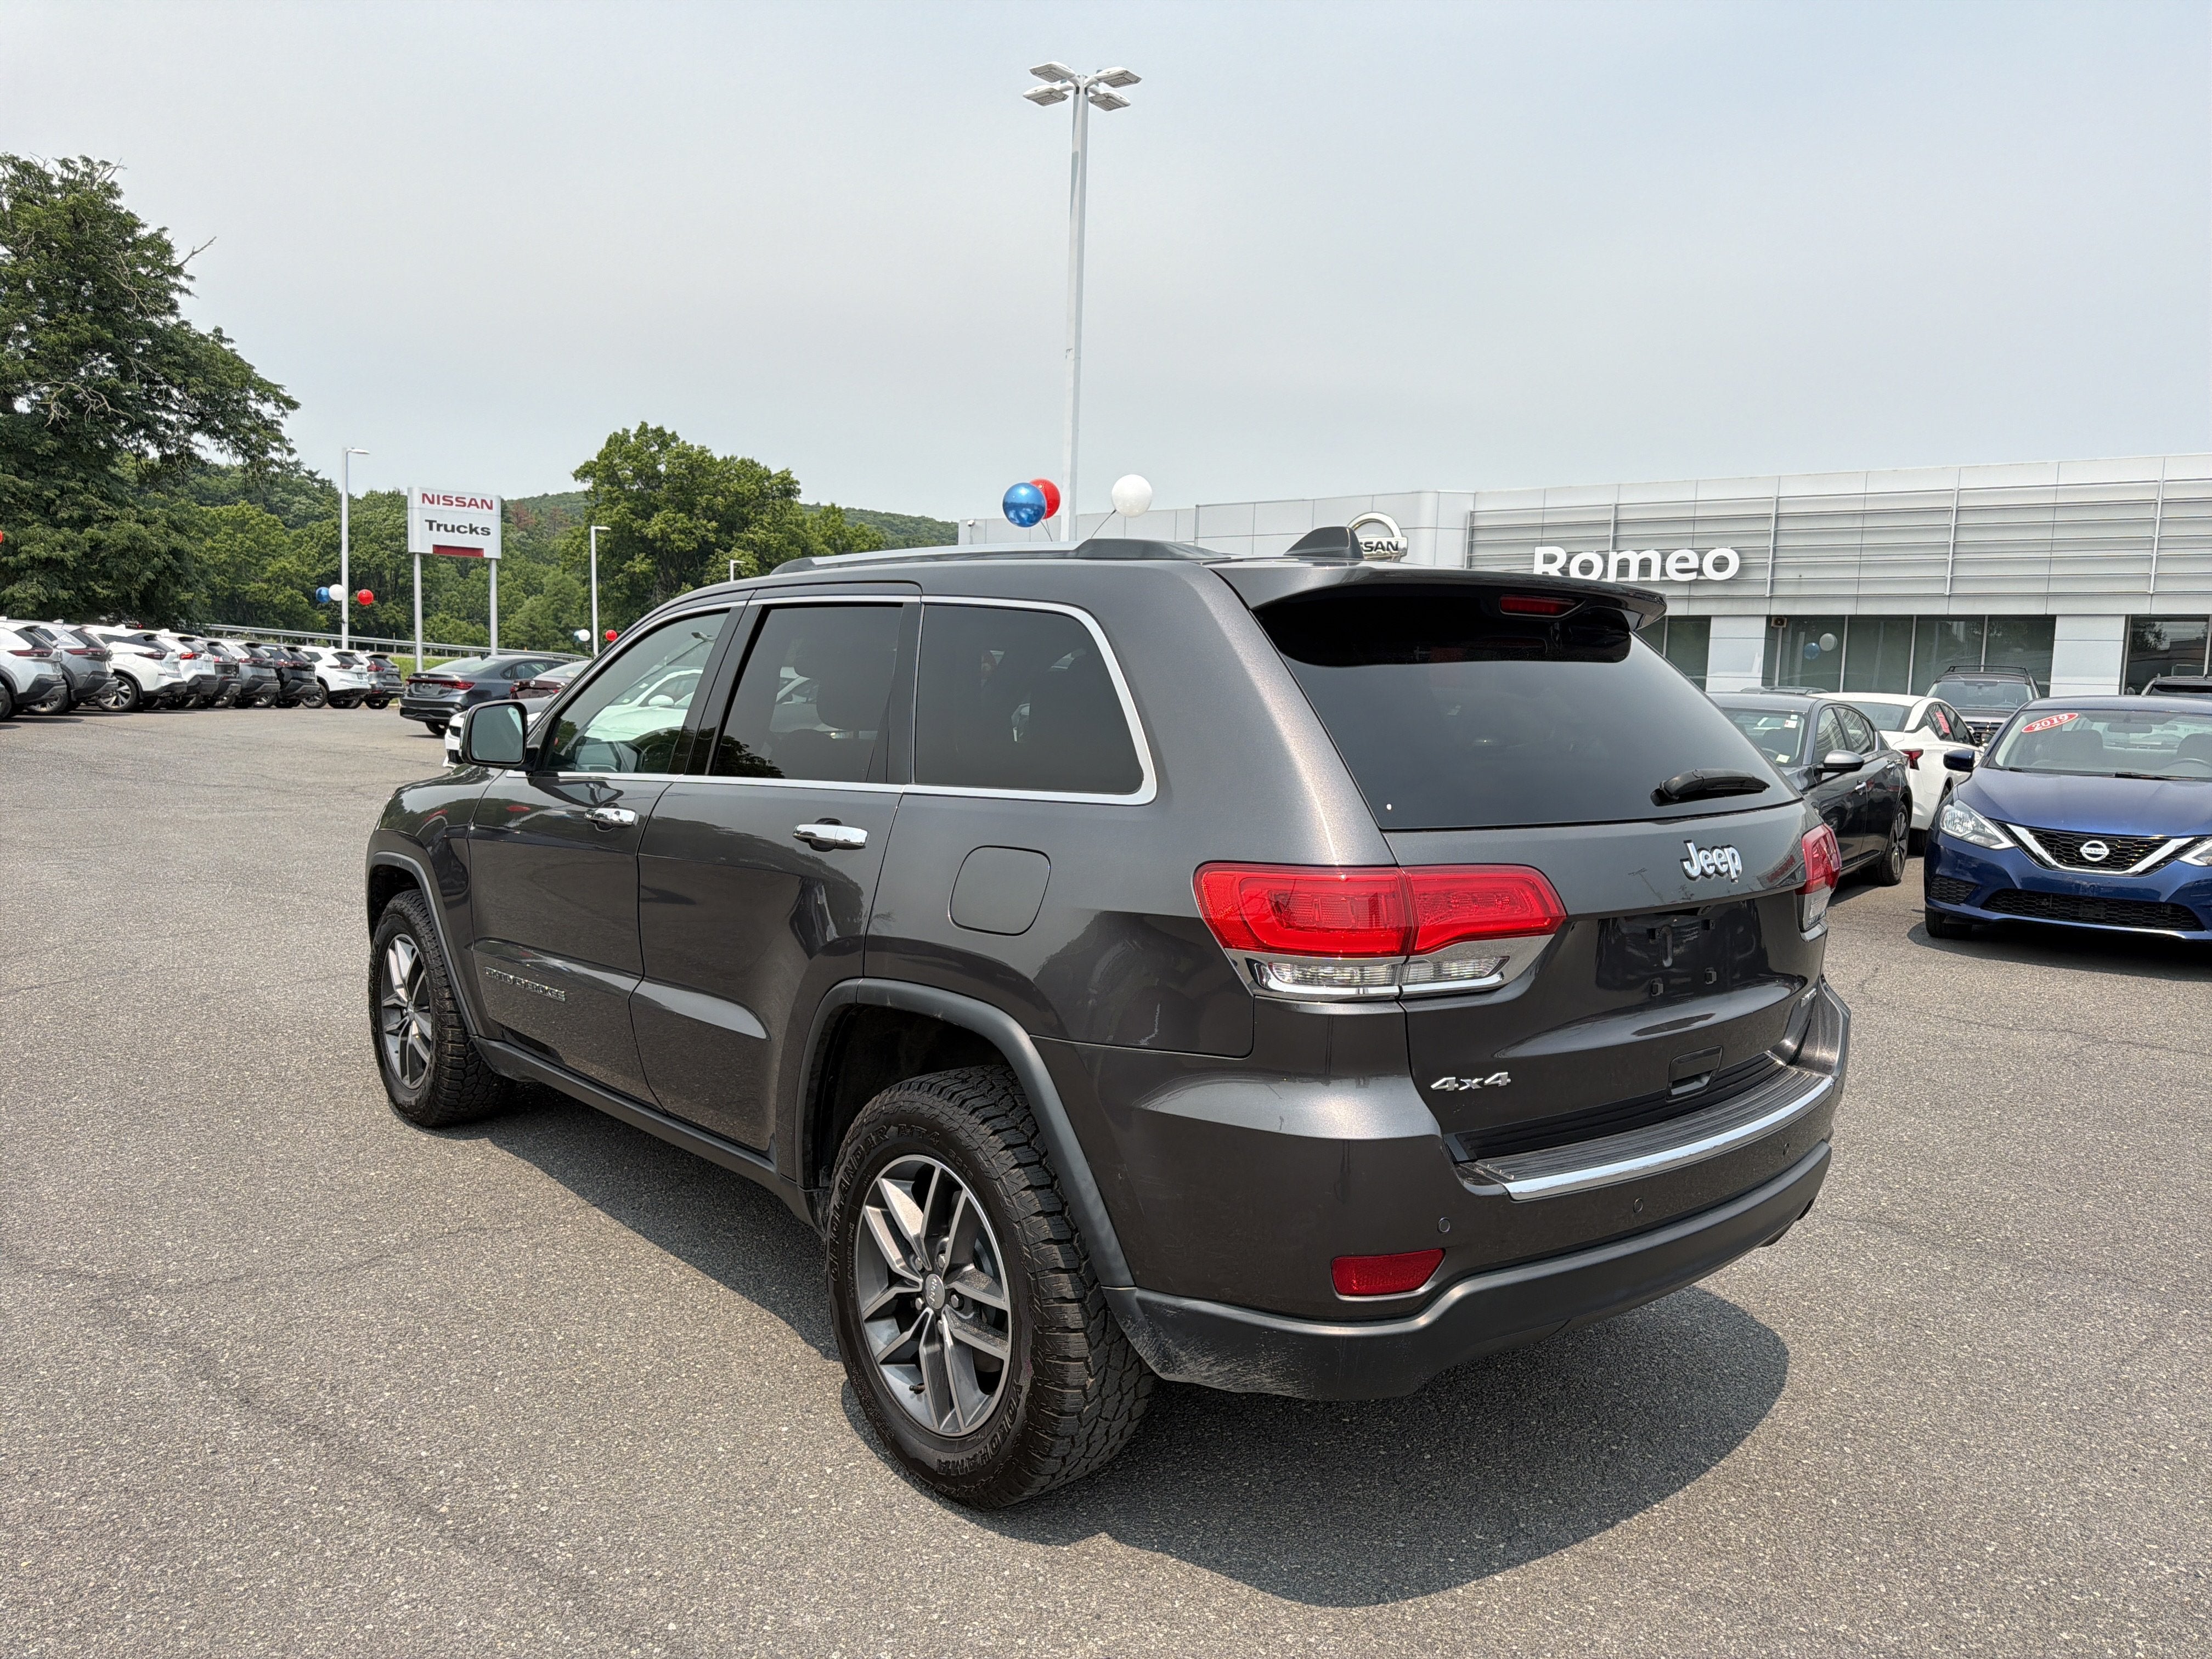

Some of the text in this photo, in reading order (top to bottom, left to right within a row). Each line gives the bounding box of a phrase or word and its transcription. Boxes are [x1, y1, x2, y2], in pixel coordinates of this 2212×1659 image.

[421, 493, 493, 510] NISSAN
[425, 519, 491, 536] Trucks
[1360, 540, 1398, 552] SAN
[1533, 546, 1740, 582] Romeo
[2032, 714, 2069, 730] 2019
[1680, 839, 1742, 883] Jeep
[484, 967, 515, 985] GRAND
[936, 1378, 1023, 1476] YOKOHAMA
